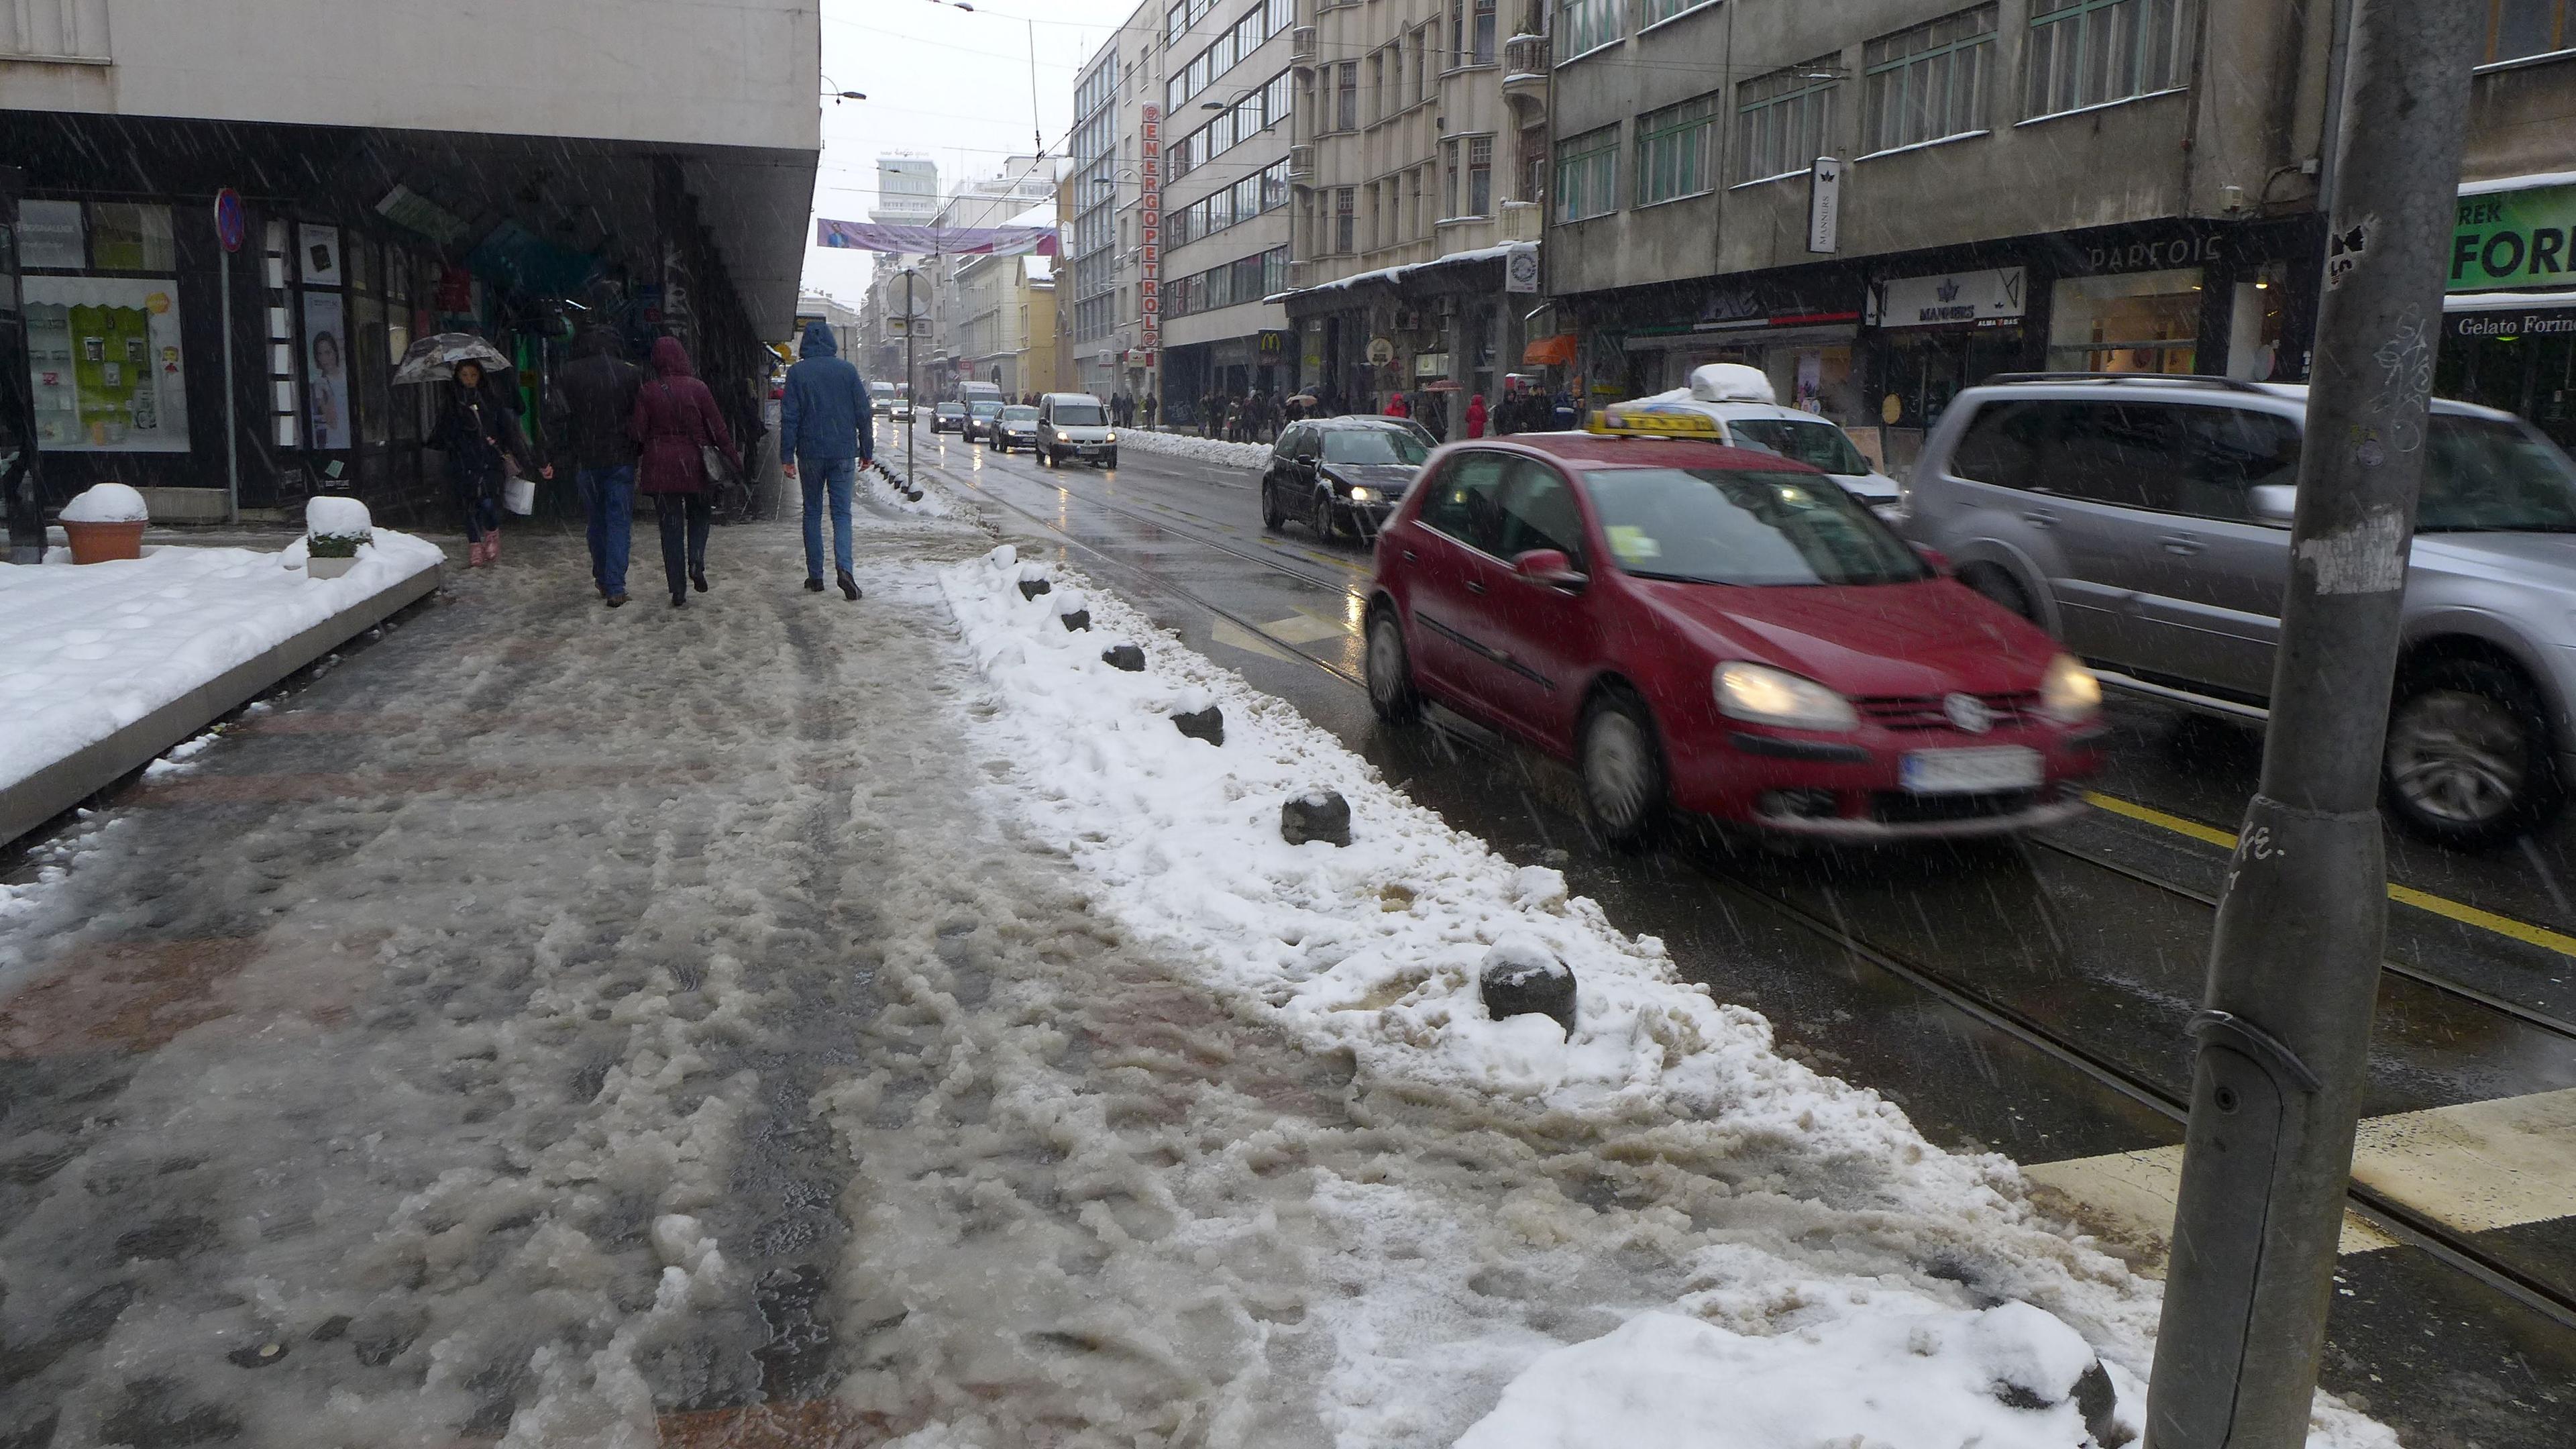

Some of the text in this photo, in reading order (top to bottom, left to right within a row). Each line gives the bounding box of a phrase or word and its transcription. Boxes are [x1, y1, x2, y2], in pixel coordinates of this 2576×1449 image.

[1144, 124, 1158, 329] ENERGOPETROL
[1819, 195, 1829, 245] MANNERS
[1919, 304, 1975, 322] MANNERS
[2458, 317, 2517, 335] Gelato
